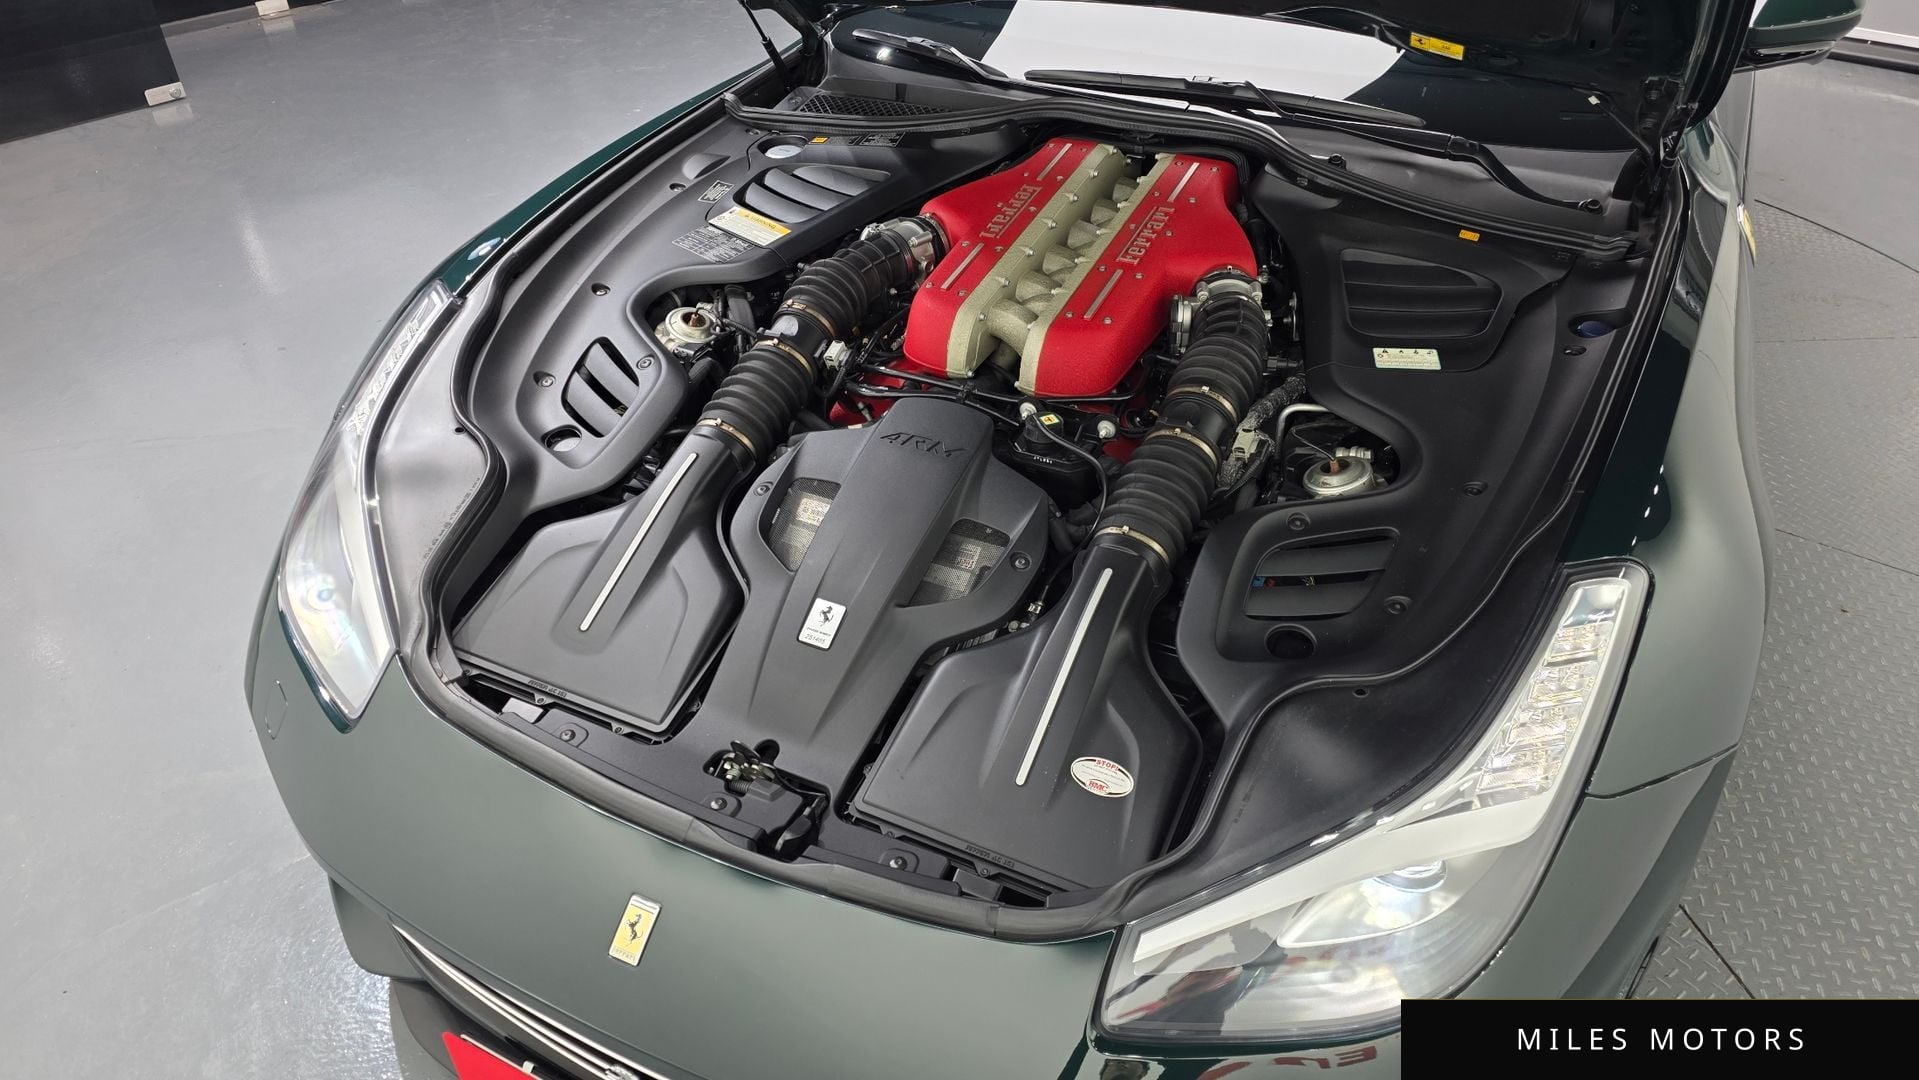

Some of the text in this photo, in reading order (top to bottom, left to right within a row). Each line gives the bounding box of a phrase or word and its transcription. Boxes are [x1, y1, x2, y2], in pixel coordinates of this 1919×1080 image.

[979, 184, 1043, 238] Ferrari
[1116, 205, 1176, 266] Ferrari
[1095, 759, 1119, 772] STOP!
[1088, 780, 1109, 792] BMC
